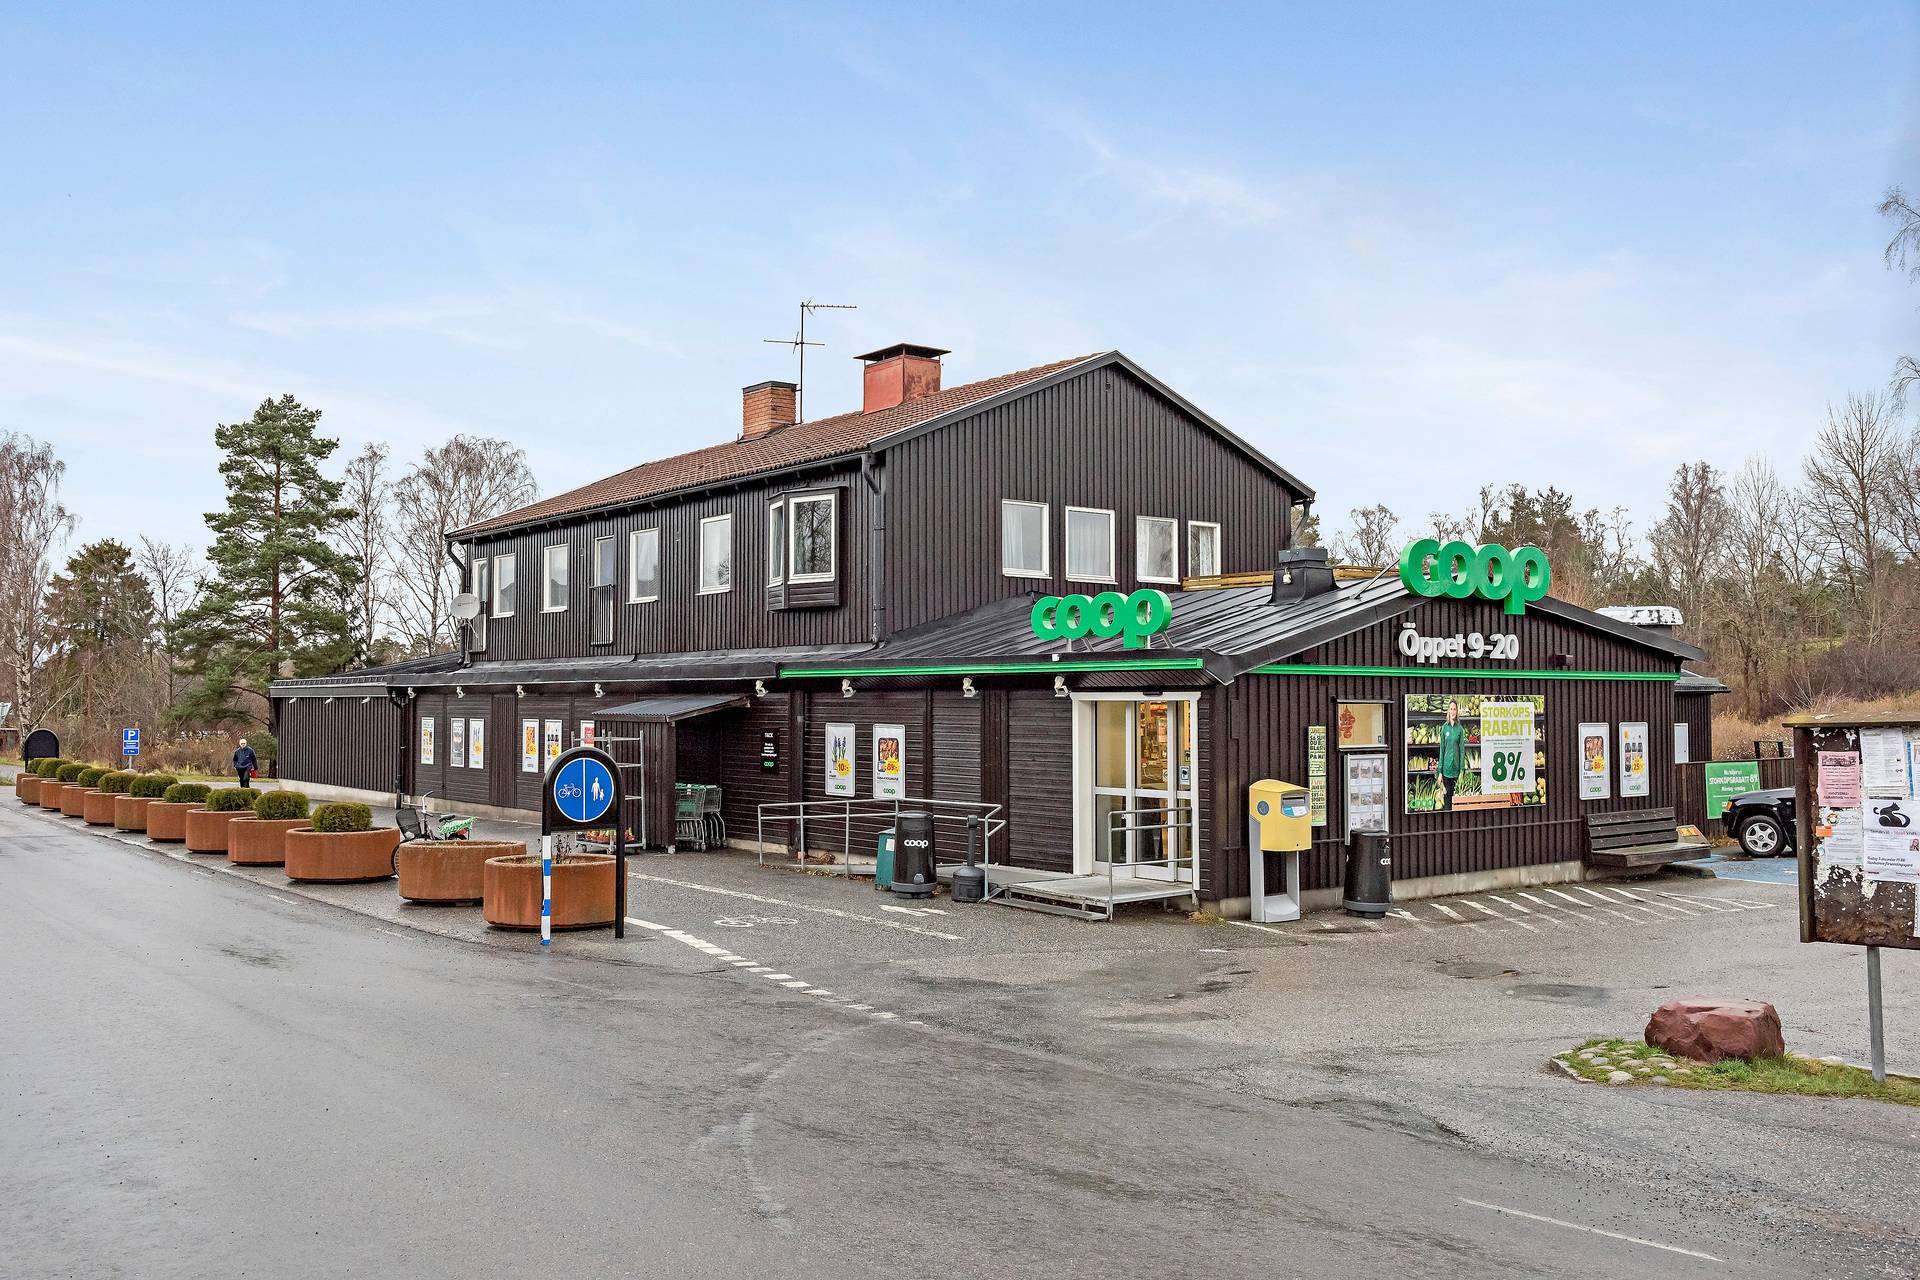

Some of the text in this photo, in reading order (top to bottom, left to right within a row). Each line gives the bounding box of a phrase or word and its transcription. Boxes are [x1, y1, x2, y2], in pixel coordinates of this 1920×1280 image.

[1400, 538, 1550, 615] coop
[1031, 588, 1172, 649] coop
[1399, 622, 1520, 664] Öppet 9-20
[127, 730, 136, 741] P
[1482, 719, 1533, 737] RABATT
[1491, 751, 1526, 782] 8%
[904, 840, 928, 848] coop
